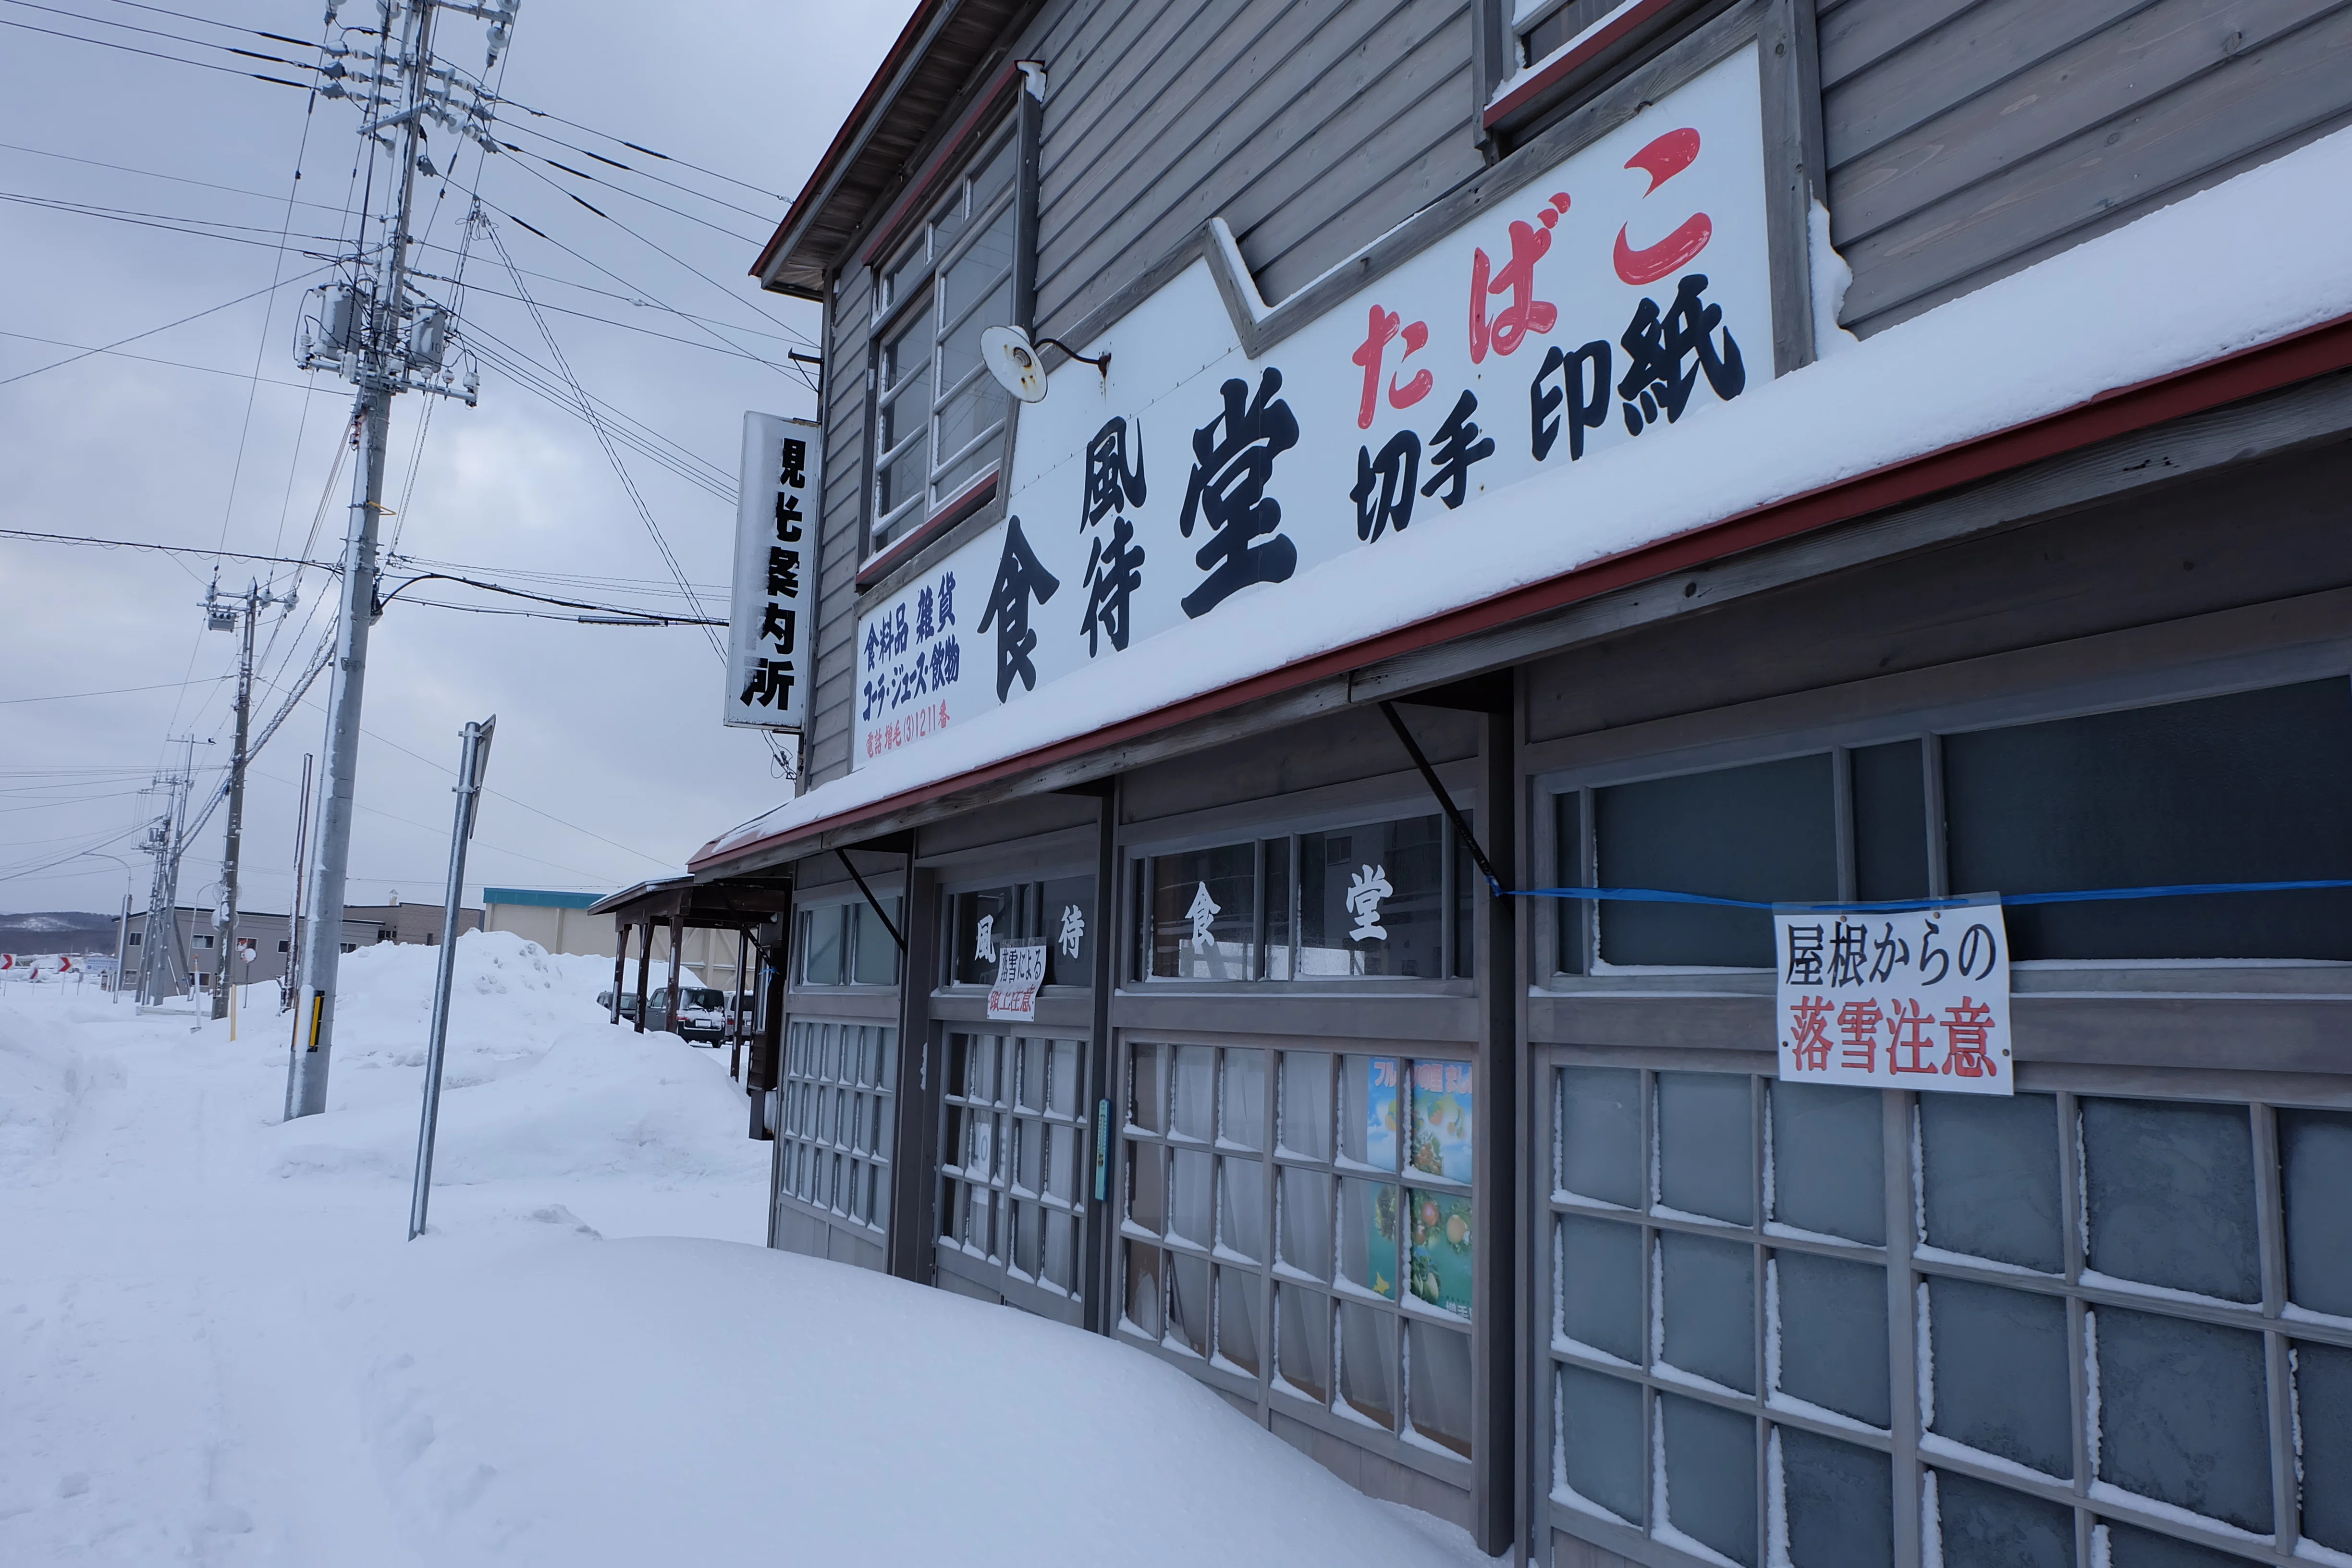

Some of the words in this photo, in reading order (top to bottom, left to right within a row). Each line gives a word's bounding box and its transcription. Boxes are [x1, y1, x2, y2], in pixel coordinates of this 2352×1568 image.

[1352, 127, 1713, 429] たばこ
[1349, 389, 1495, 544] 切手
[1531, 273, 1746, 462] 印紙
[1079, 416, 1147, 659] 風待
[863, 602, 909, 673] 食料品
[916, 570, 956, 645] 雑貨
[990, 984, 1036, 1012] 頭上注意
[1000, 948, 1041, 982] 落雪による
[1786, 919, 1997, 988] 屋根からの
[1789, 995, 1997, 1078] 落雪注意
